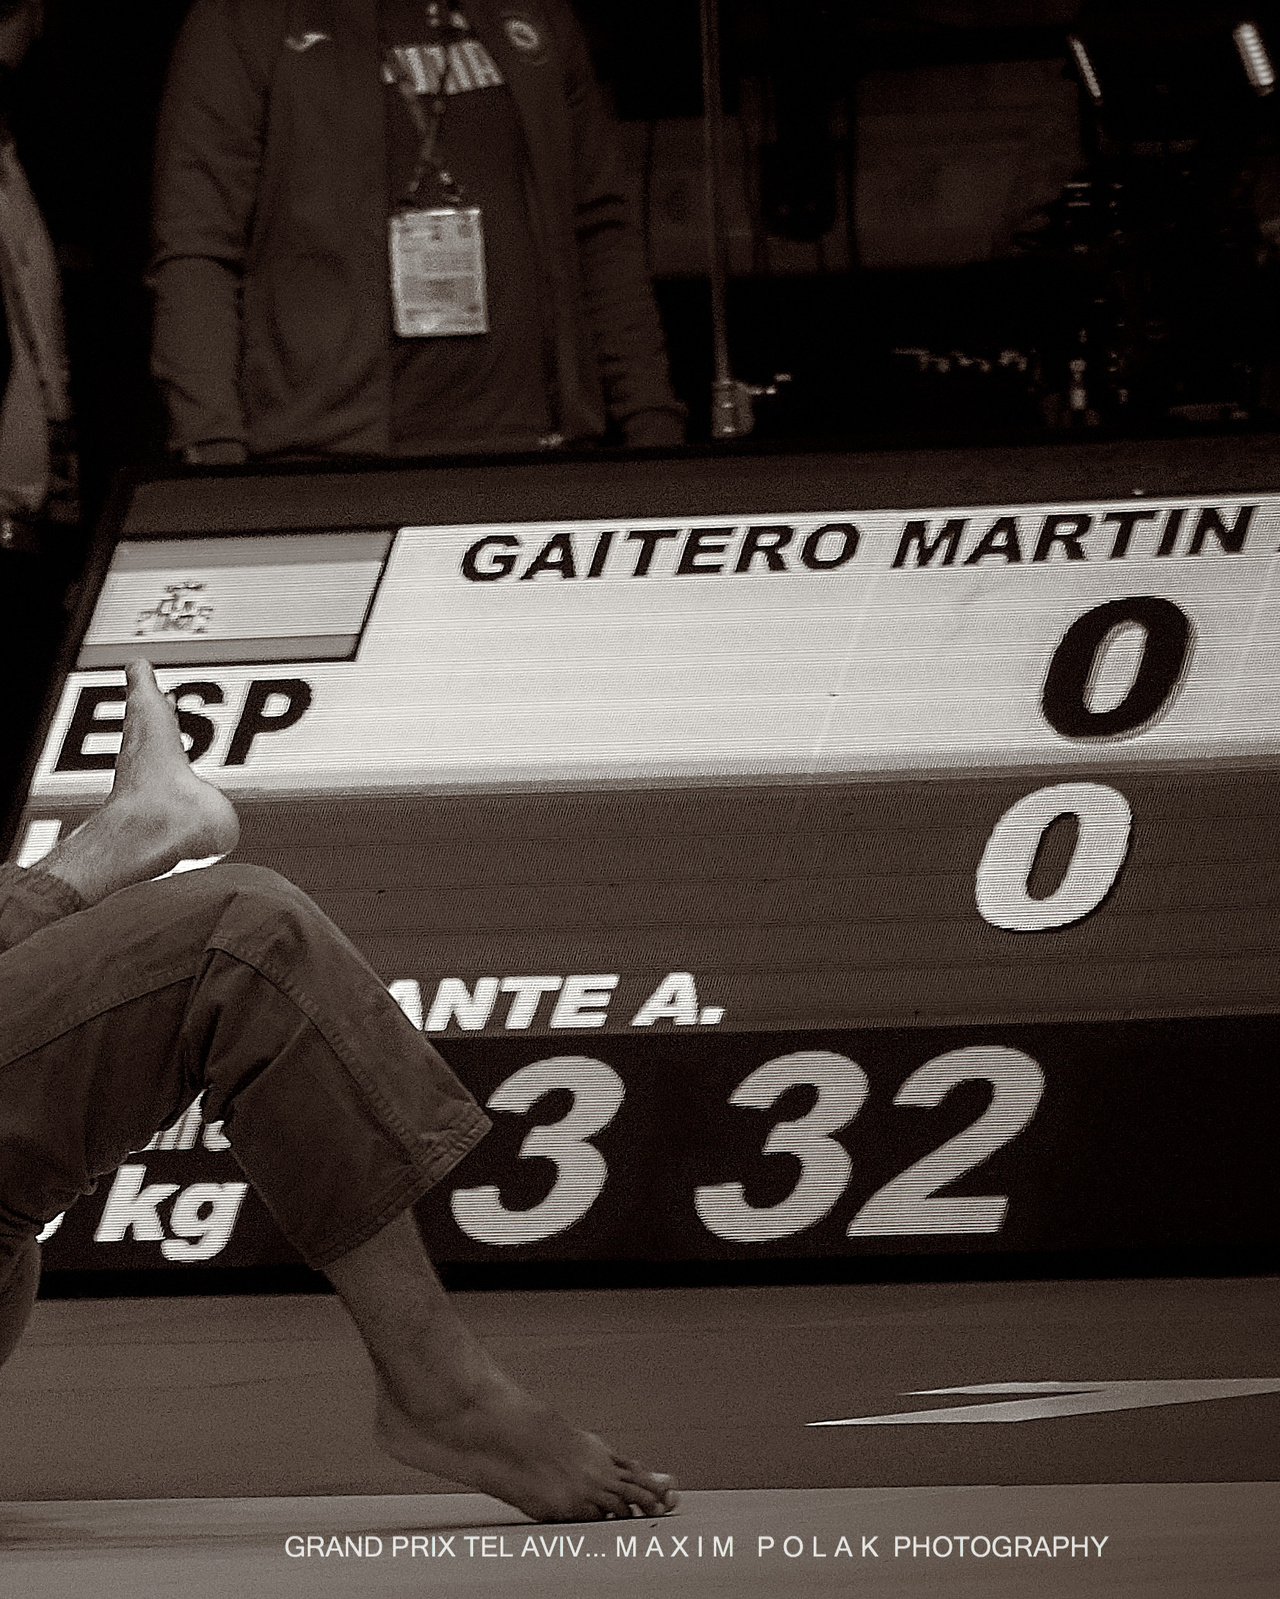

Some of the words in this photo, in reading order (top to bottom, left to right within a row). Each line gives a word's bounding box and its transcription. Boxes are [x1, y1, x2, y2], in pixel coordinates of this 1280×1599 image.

[461, 522, 862, 583] GAITERO
[892, 505, 1259, 570] MARTIN
[1041, 596, 1195, 741] 0
[53, 677, 313, 773] ESP
[976, 782, 1132, 932] 0
[631, 971, 726, 1028] A.
[450, 1055, 626, 1247] 3
[693, 1045, 1046, 1244] 32
[93, 1164, 249, 1263] kg
